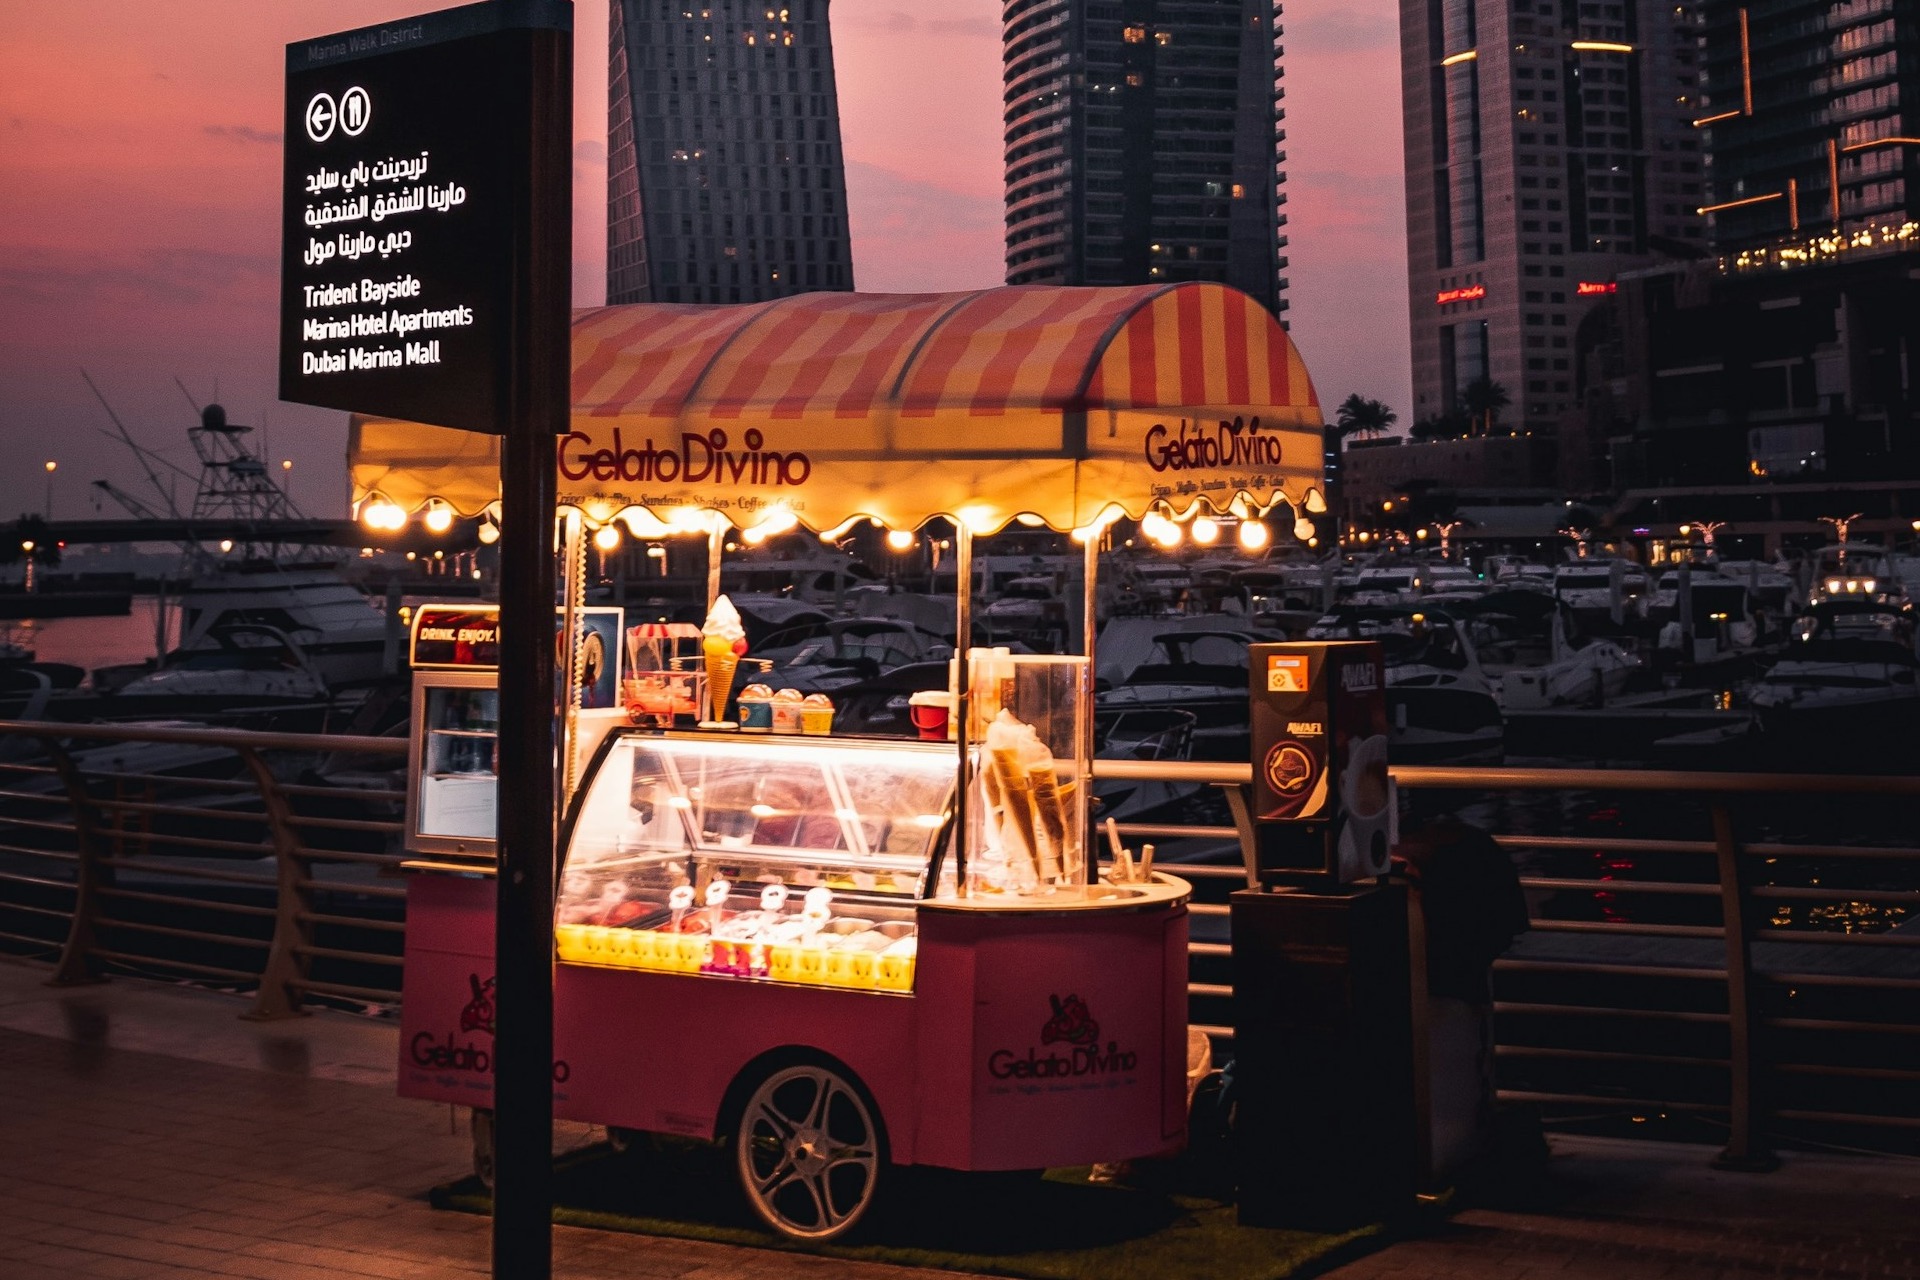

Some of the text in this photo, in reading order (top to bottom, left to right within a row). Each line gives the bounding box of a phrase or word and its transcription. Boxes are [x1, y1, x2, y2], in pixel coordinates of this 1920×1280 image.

[308, 24, 423, 62] Marina Walk District
[305, 151, 429, 195] تريدينت باي سايد
[304, 181, 466, 229] مارينا للشقق الفندقية
[304, 230, 412, 266] دبي مارينا مول
[303, 274, 421, 308] Trident Bayside
[303, 304, 473, 341] Marina Hotel Apartments
[302, 340, 440, 375] Dubai Marina Mall
[420, 628, 456, 641] DRINK.
[457, 628, 495, 645] ENJOY.
